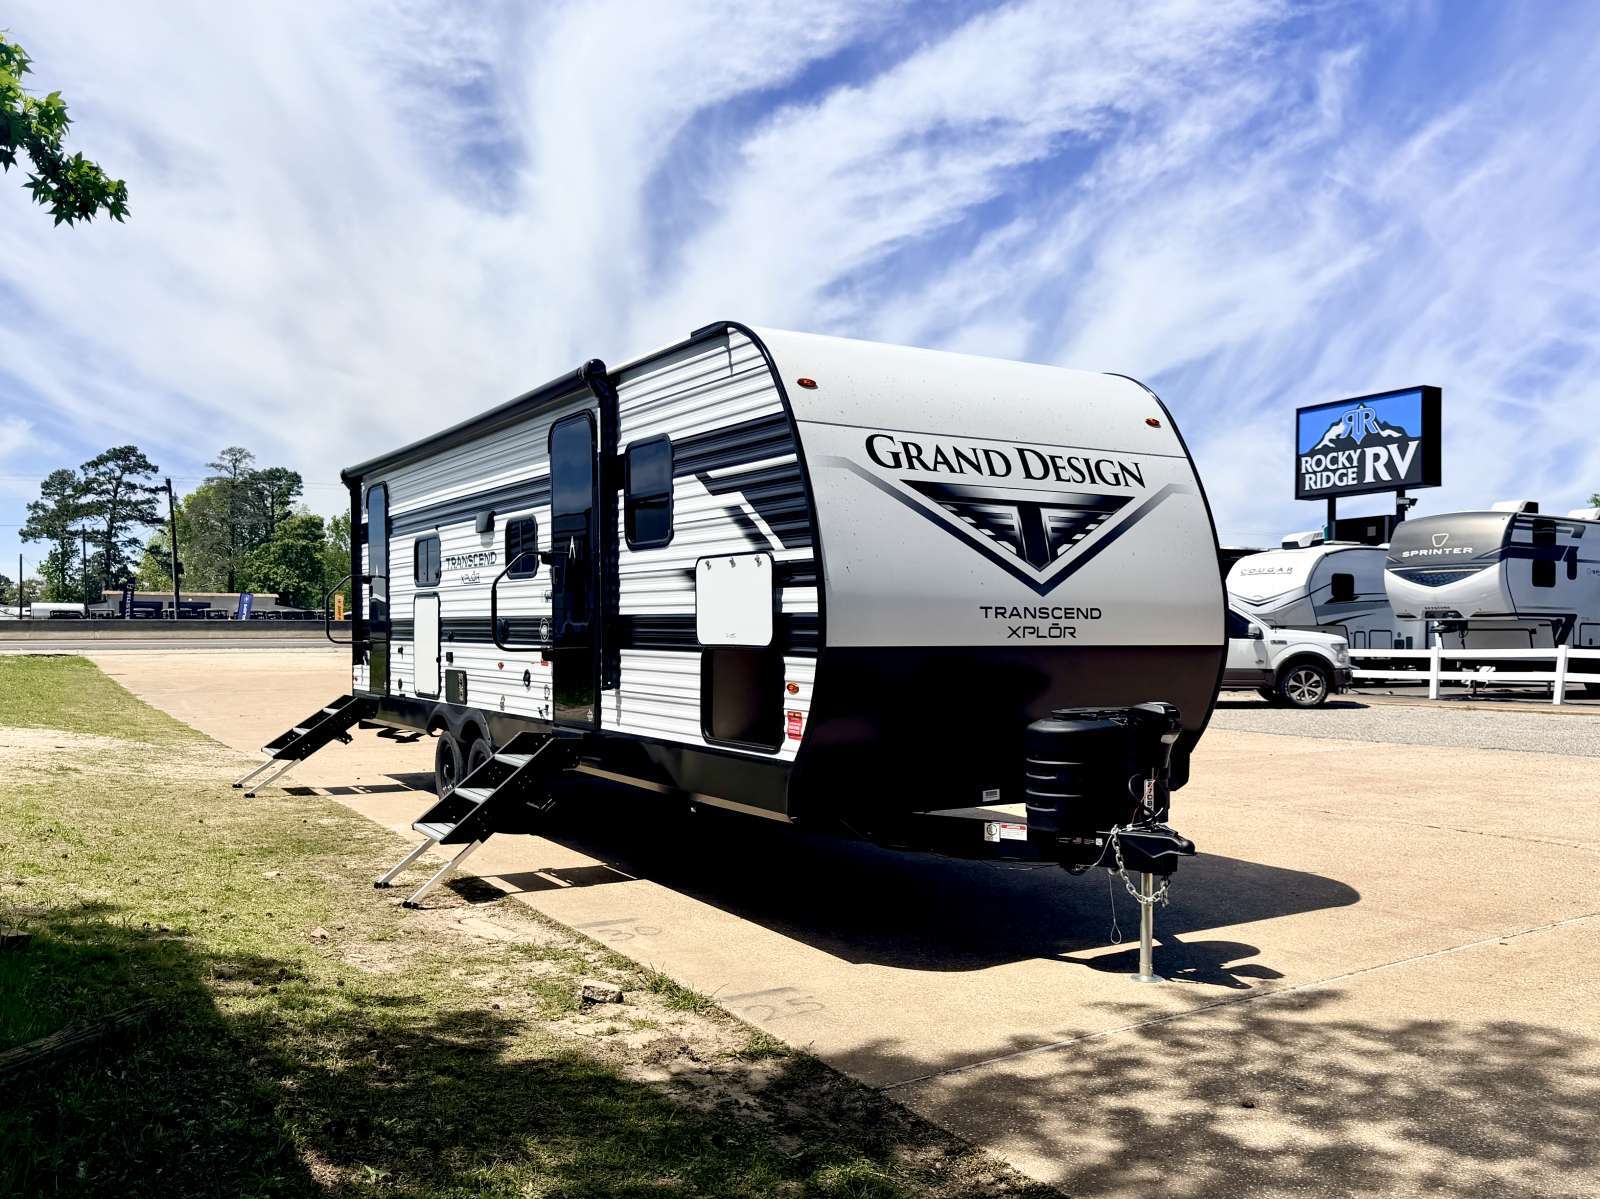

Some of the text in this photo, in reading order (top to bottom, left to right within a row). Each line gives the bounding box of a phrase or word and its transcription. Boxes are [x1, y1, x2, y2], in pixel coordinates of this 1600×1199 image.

[865, 433, 1146, 489] GRAND DESIGN
[1301, 448, 1361, 474] ROCKY
[1363, 440, 1420, 484] RV
[1304, 467, 1358, 491] RIDGE
[446, 551, 497, 570] TRANSCEND
[1402, 547, 1473, 558] SPRINTER
[979, 606, 1102, 620] TRANSCEND
